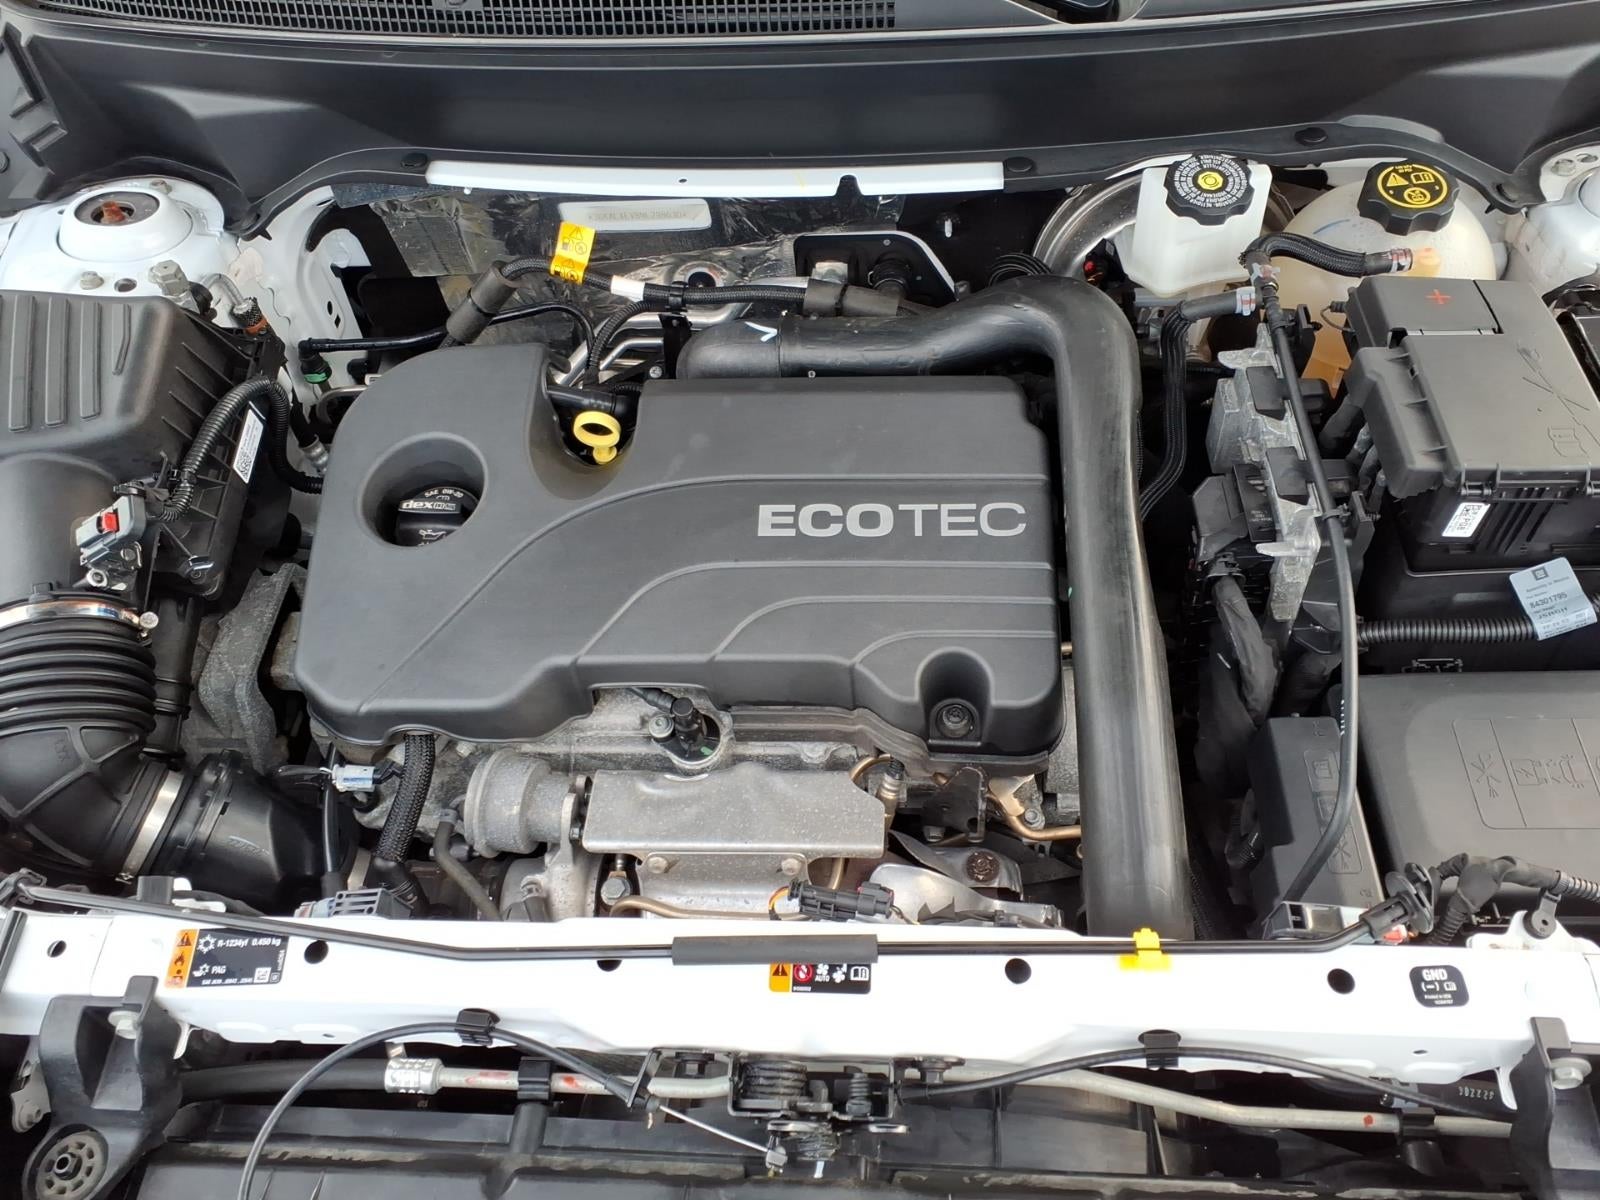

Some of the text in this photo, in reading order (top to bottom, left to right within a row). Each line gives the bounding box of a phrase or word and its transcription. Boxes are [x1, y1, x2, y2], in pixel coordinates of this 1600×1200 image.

[757, 502, 1027, 538] ECOTEC
[217, 939, 249, 948] R-1234yf
[211, 965, 227, 974] PAG
[1422, 968, 1448, 981] GND
